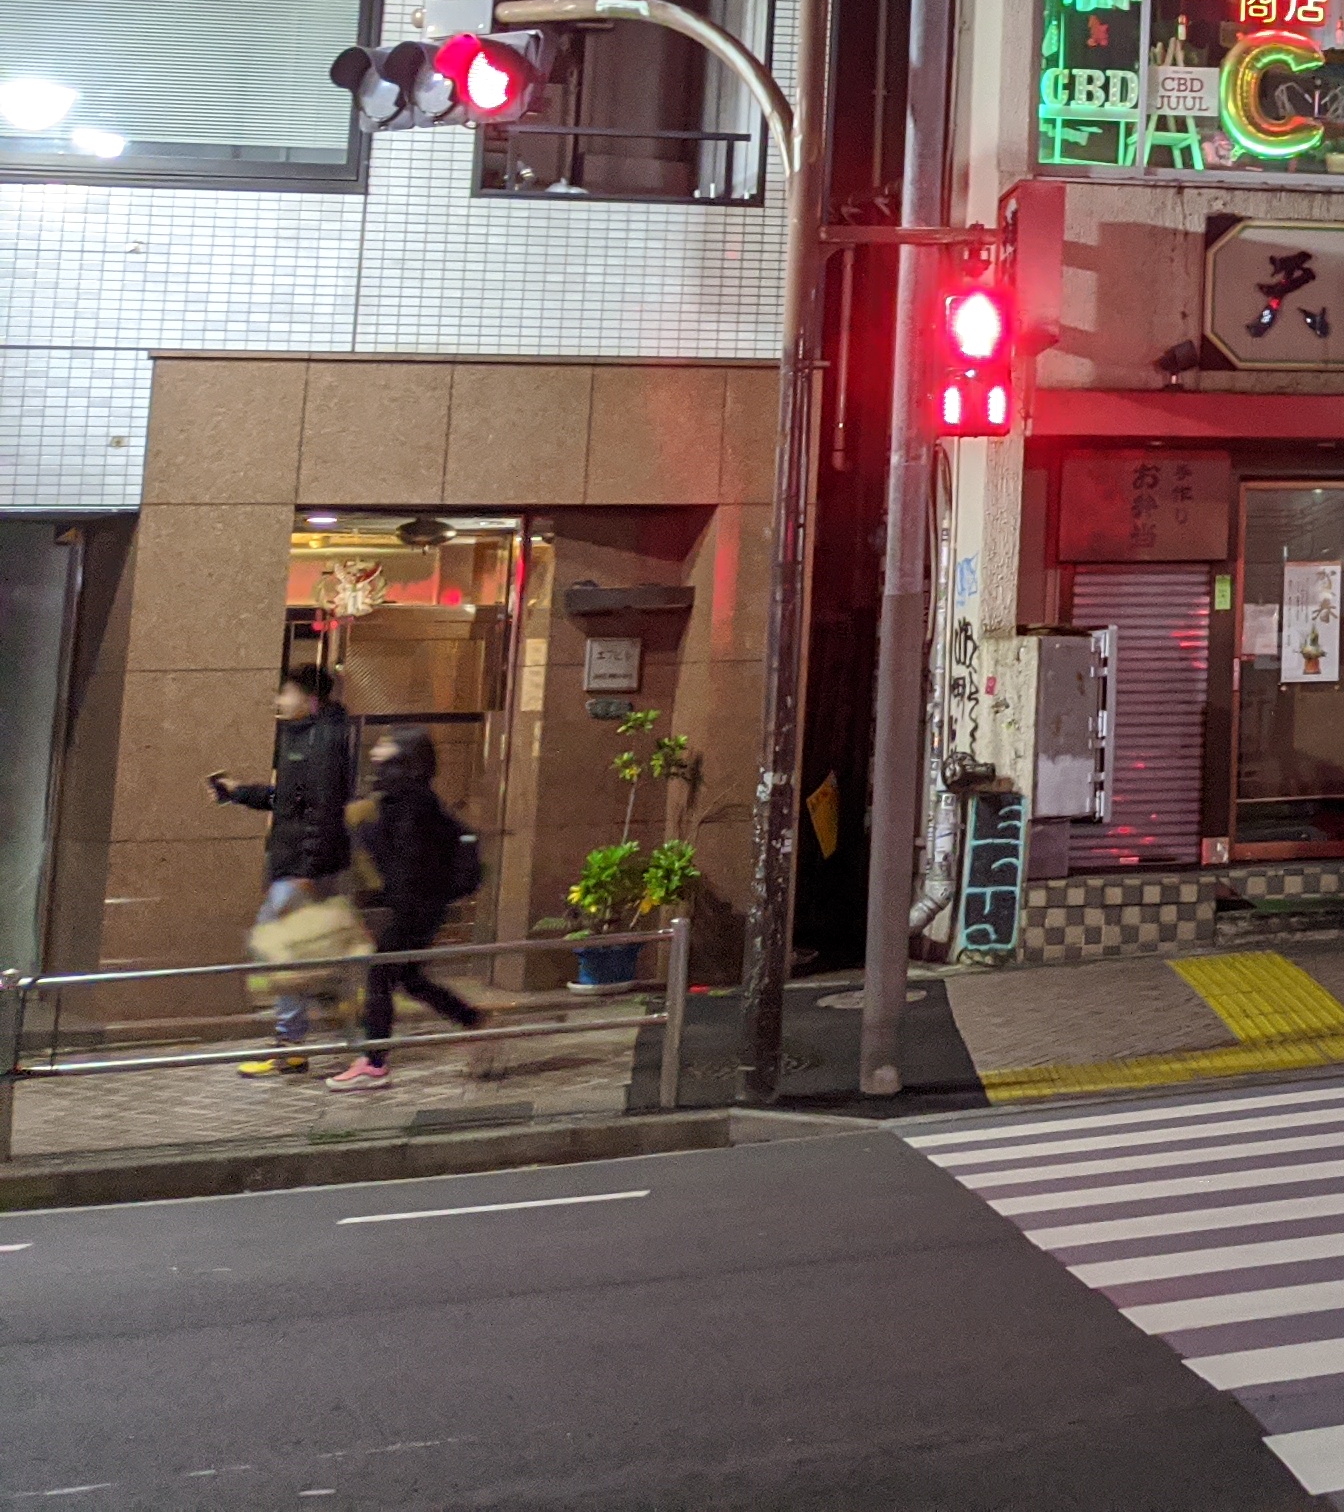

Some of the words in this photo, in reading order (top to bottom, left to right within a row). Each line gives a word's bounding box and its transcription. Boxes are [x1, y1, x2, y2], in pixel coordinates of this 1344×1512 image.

[1040, 68, 1138, 109] CBD
[1161, 76, 1205, 94] CBD
[1155, 95, 1210, 113] JUUL
